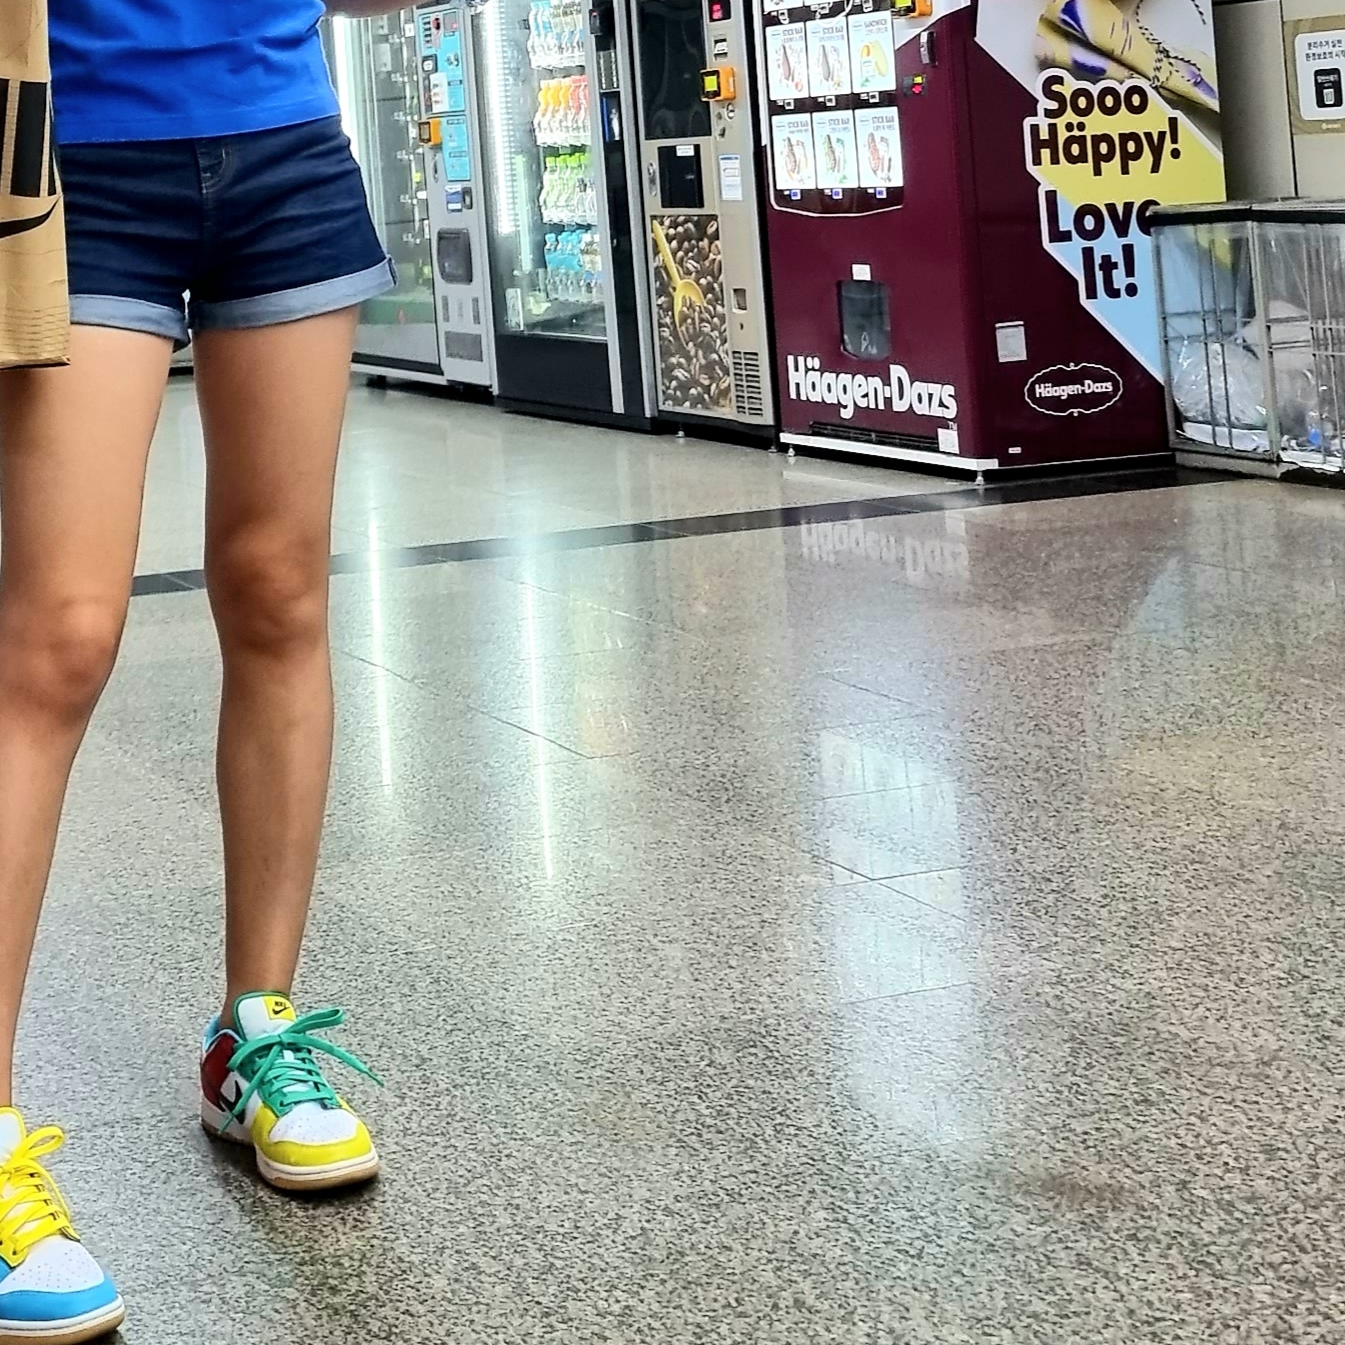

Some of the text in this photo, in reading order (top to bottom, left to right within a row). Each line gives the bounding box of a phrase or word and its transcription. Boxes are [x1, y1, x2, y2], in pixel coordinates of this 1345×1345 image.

[1042, 75, 1149, 119] Sooo
[1030, 117, 1182, 177] Häppy!
[1081, 244, 1139, 301] It!
[787, 355, 957, 420] Häagen-Dazs
[1035, 379, 1113, 400] Häagen-Dazs
